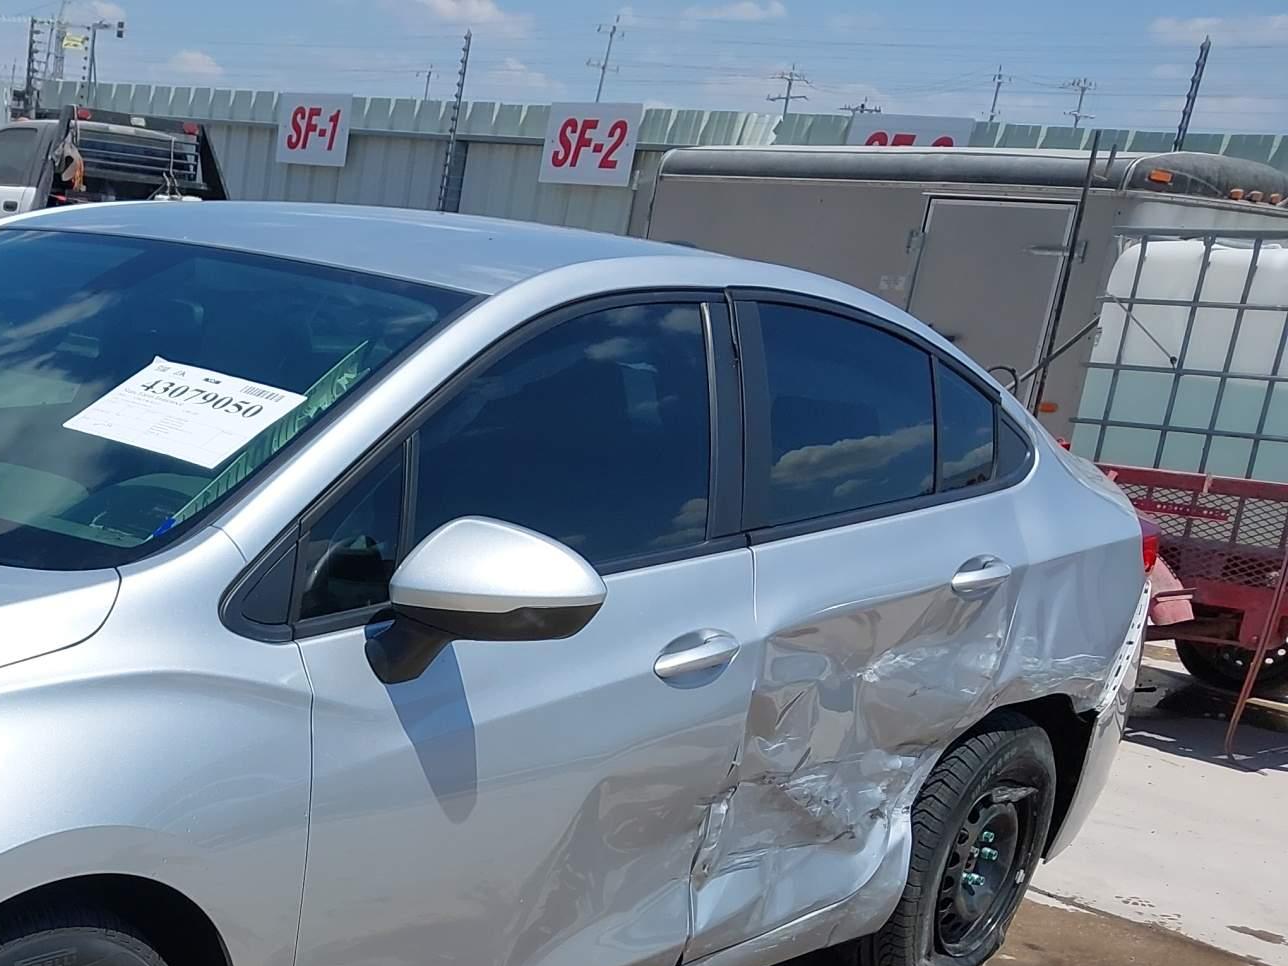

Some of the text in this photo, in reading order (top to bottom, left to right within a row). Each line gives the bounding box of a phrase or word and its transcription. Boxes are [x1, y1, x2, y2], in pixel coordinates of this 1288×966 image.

[287, 106, 341, 151] SF-1
[552, 118, 628, 169] SF-2
[140, 379, 263, 418] 43079050
